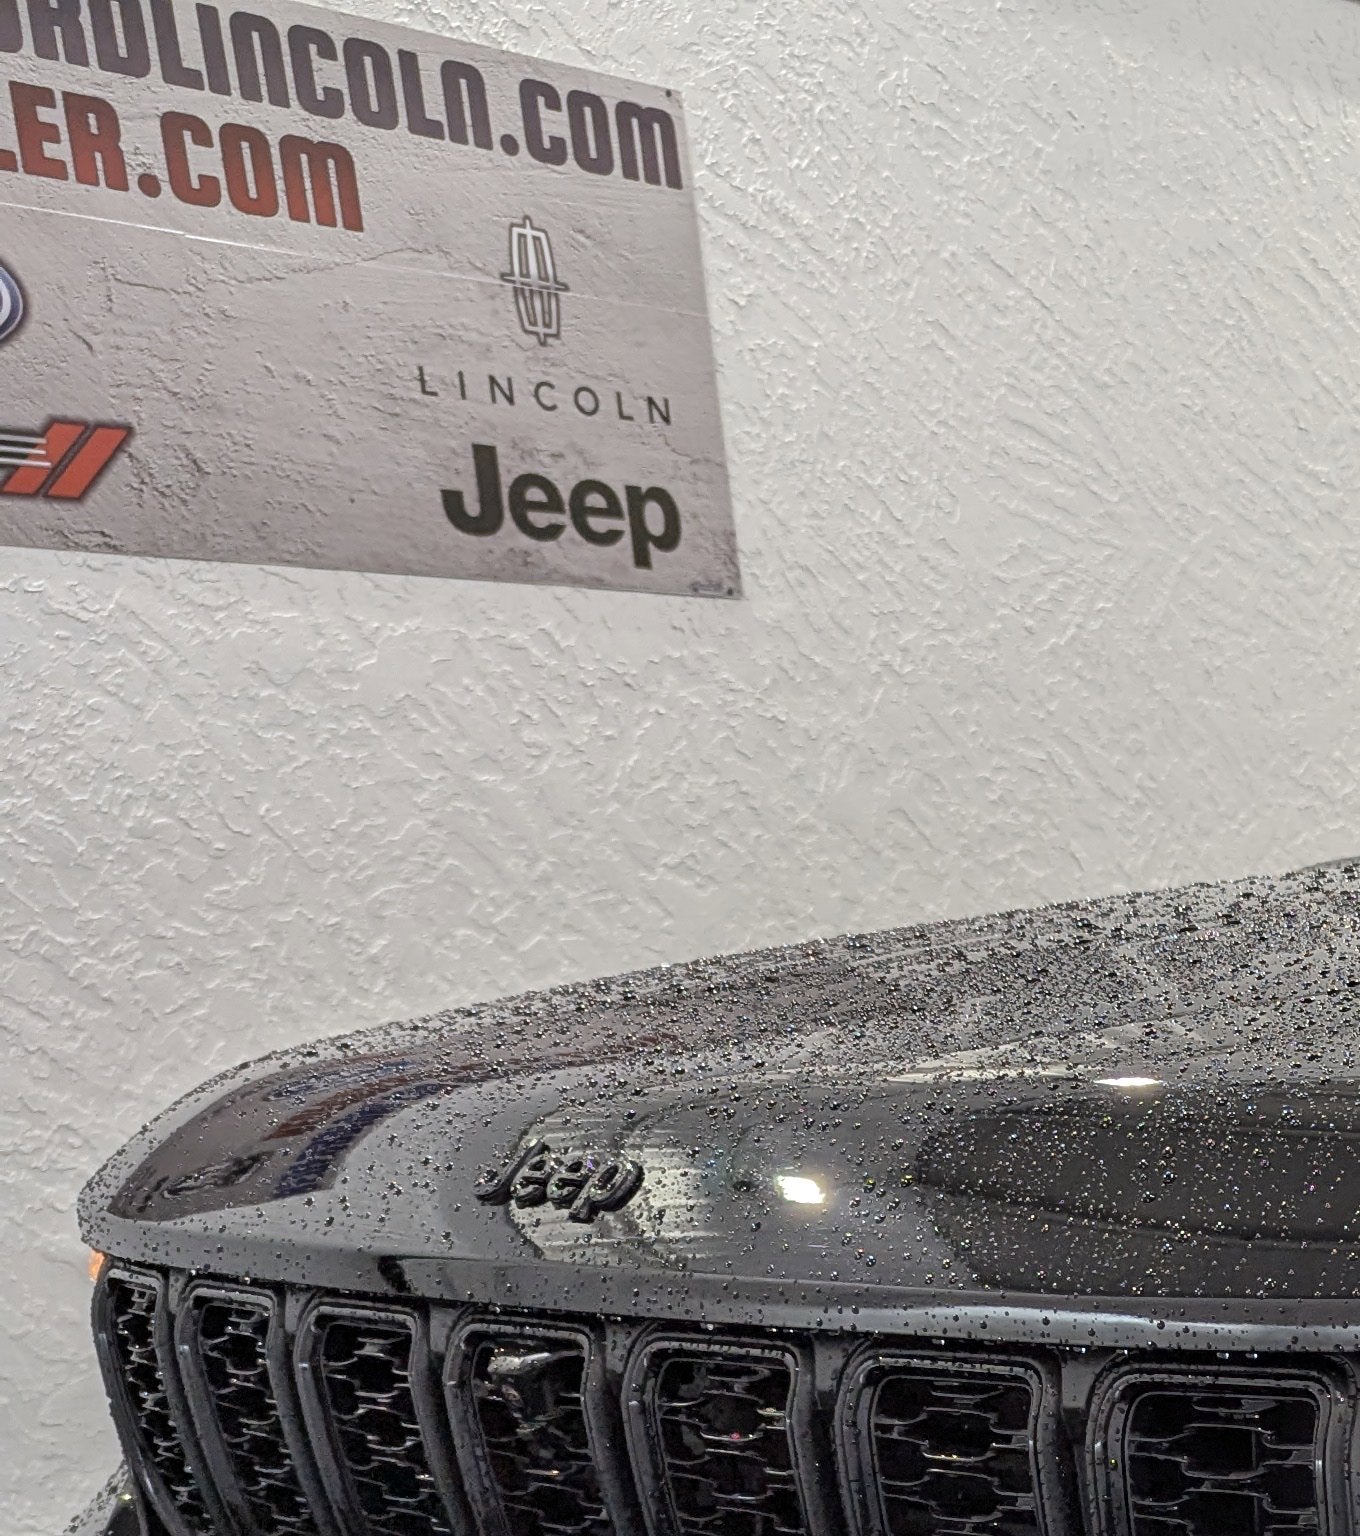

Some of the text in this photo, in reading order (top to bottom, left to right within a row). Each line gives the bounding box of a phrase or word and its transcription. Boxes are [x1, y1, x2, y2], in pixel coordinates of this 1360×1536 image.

[0, 80, 364, 233] ER.COM
[417, 365, 671, 426] LINCOLN
[440, 442, 682, 570] Jeep
[475, 1140, 645, 1224] Jeep
